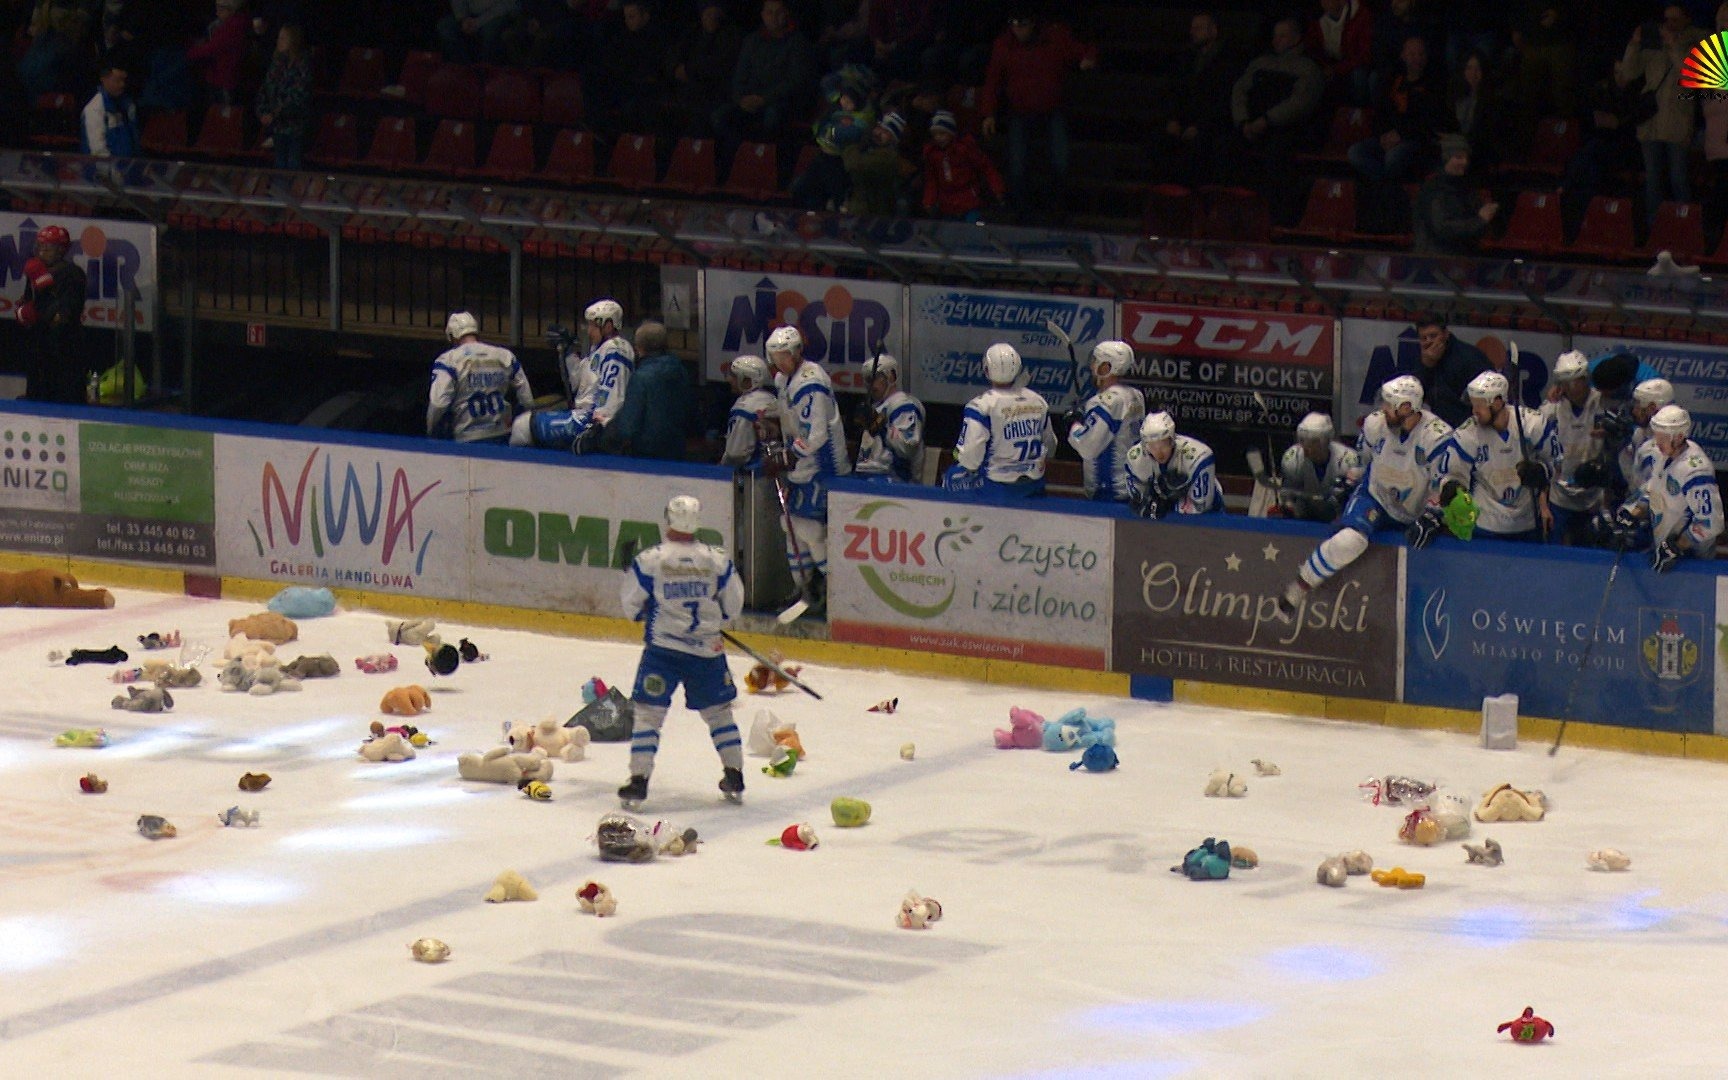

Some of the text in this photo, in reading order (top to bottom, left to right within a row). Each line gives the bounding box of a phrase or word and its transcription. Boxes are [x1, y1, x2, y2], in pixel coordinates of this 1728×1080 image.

[1131, 312, 1324, 357] CCM
[1129, 358, 1324, 390] MADE OF HOCKEY
[1181, 406, 1233, 421] SYSTEM
[127, 523, 141, 537] 33
[144, 525, 163, 538] 445
[166, 526, 179, 539] 40
[138, 539, 151, 553] 33
[154, 541, 174, 555] 445
[176, 542, 190, 556] 40
[843, 524, 925, 567] ZUK
[999, 533, 1097, 576] Czysto
[270, 560, 414, 589] GALERIA HANDLOWA
[682, 601, 701, 634] 7
[972, 579, 1096, 621] i zielono
[1471, 608, 1625, 645] OŚWIĘCIM
[1141, 647, 1208, 670] HOTEL
[1229, 656, 1367, 687] RESTAURACJA
